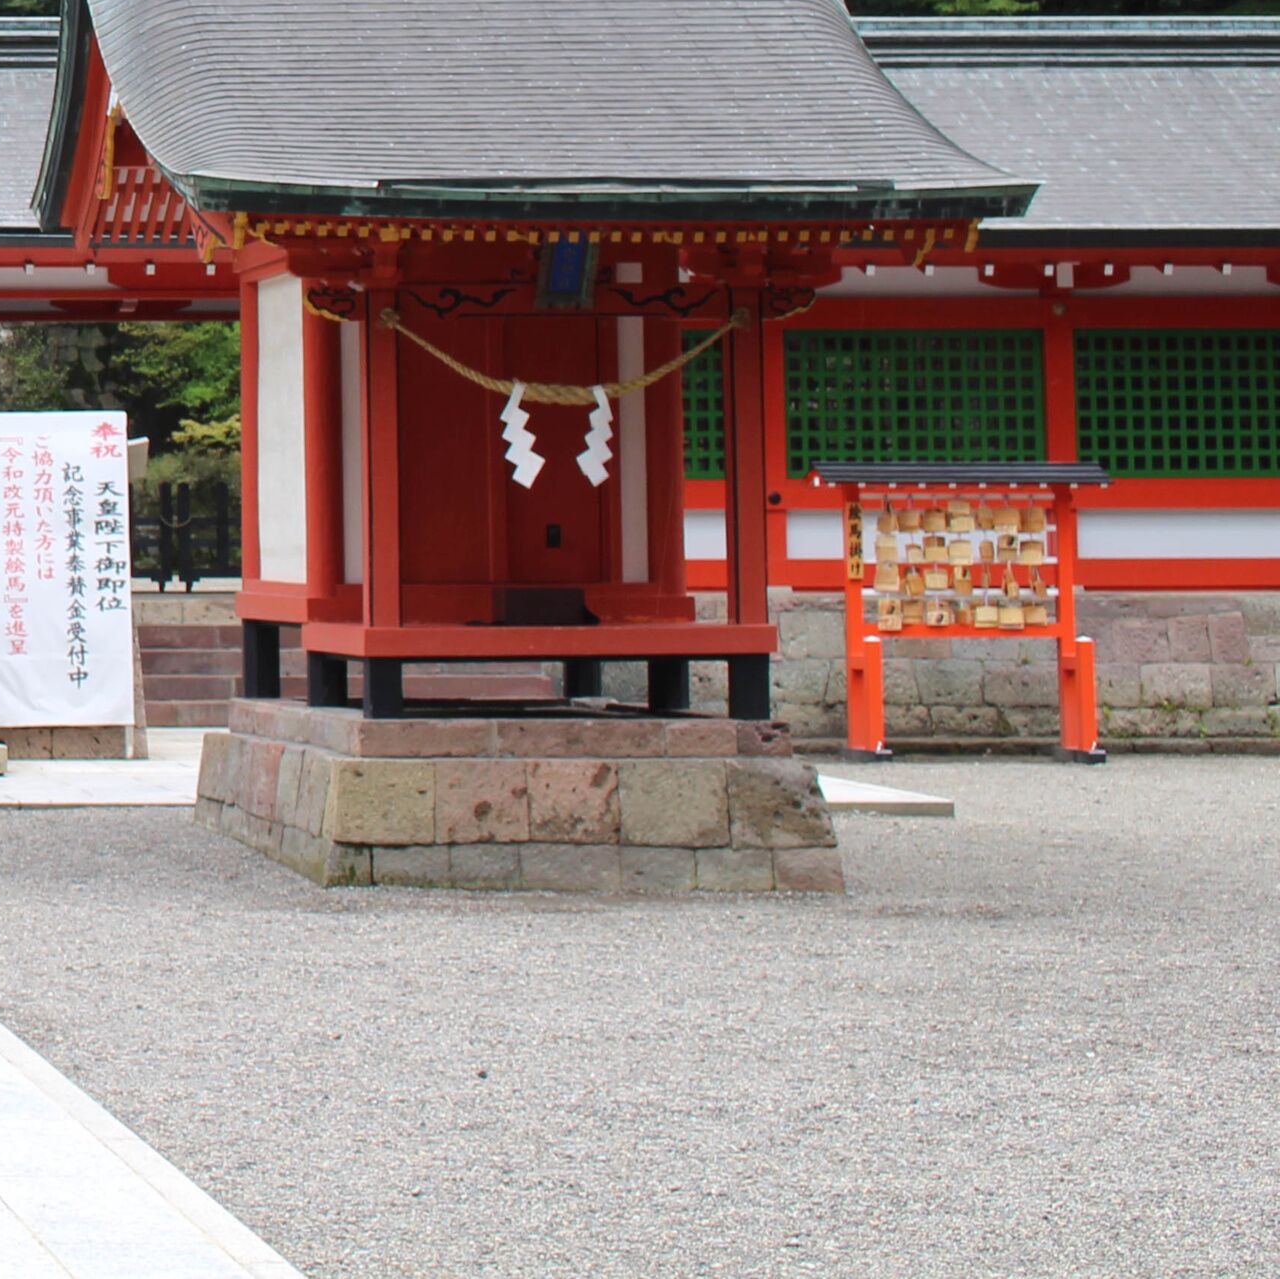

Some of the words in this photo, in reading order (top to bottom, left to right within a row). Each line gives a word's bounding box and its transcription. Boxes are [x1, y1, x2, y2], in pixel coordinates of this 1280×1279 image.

[31, 435, 56, 580] ご協力頂いた方には
[89, 422, 123, 459] 奉祝
[61, 462, 89, 690] 記念事業奉賛金受付中
[94, 481, 127, 612] 天皇陛下御即位
